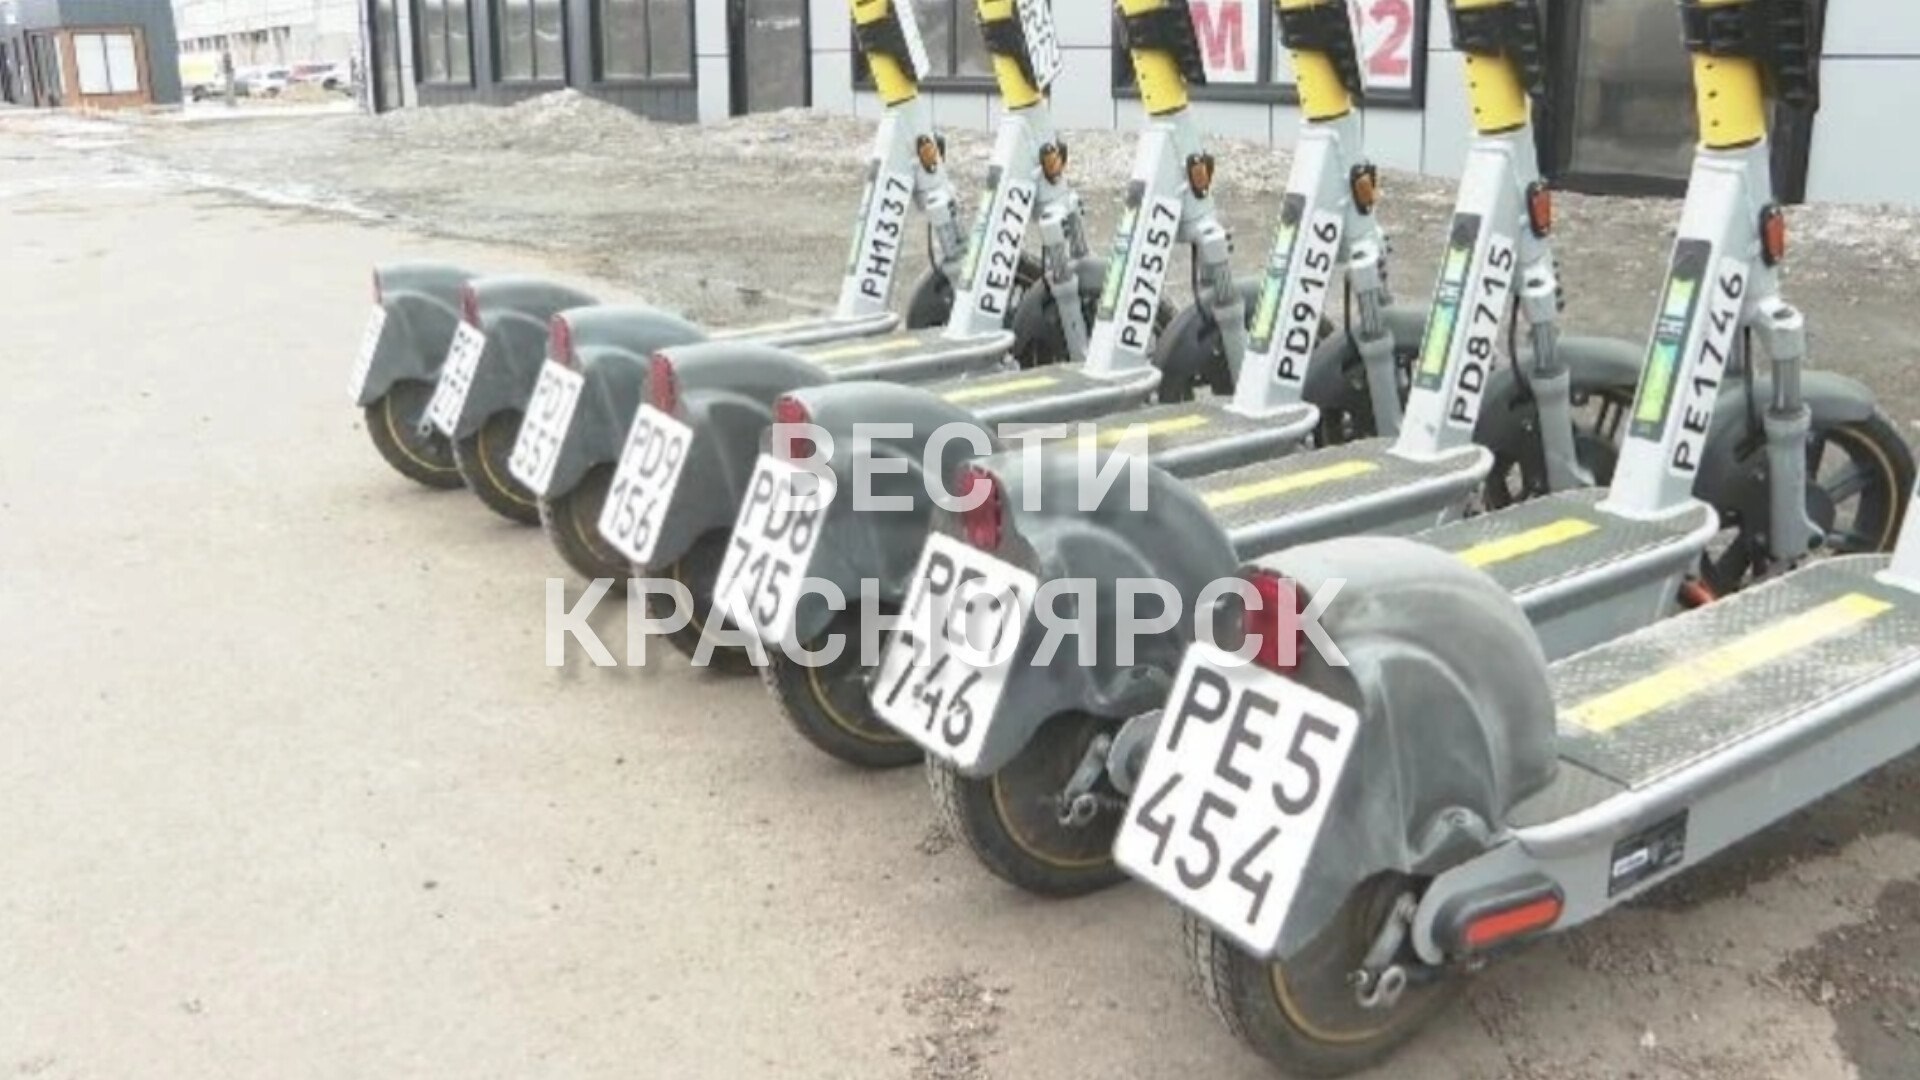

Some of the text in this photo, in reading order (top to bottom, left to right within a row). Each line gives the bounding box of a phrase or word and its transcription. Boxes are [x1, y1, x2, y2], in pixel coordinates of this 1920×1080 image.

[861, 177, 909, 297] PH1337
[980, 186, 1032, 314] PE2272
[1121, 203, 1177, 347] PD7557
[1277, 222, 1337, 381] PD9156
[1450, 248, 1511, 423] PD8715
[1673, 272, 1742, 470] PE1746
[610, 476, 658, 552] 156
[625, 418, 684, 491] PD9
[742, 469, 821, 554] PD8
[721, 536, 791, 627] 715
[885, 631, 982, 747] 746
[1167, 665, 1340, 815] PE5
[1136, 773, 1281, 925] 454
